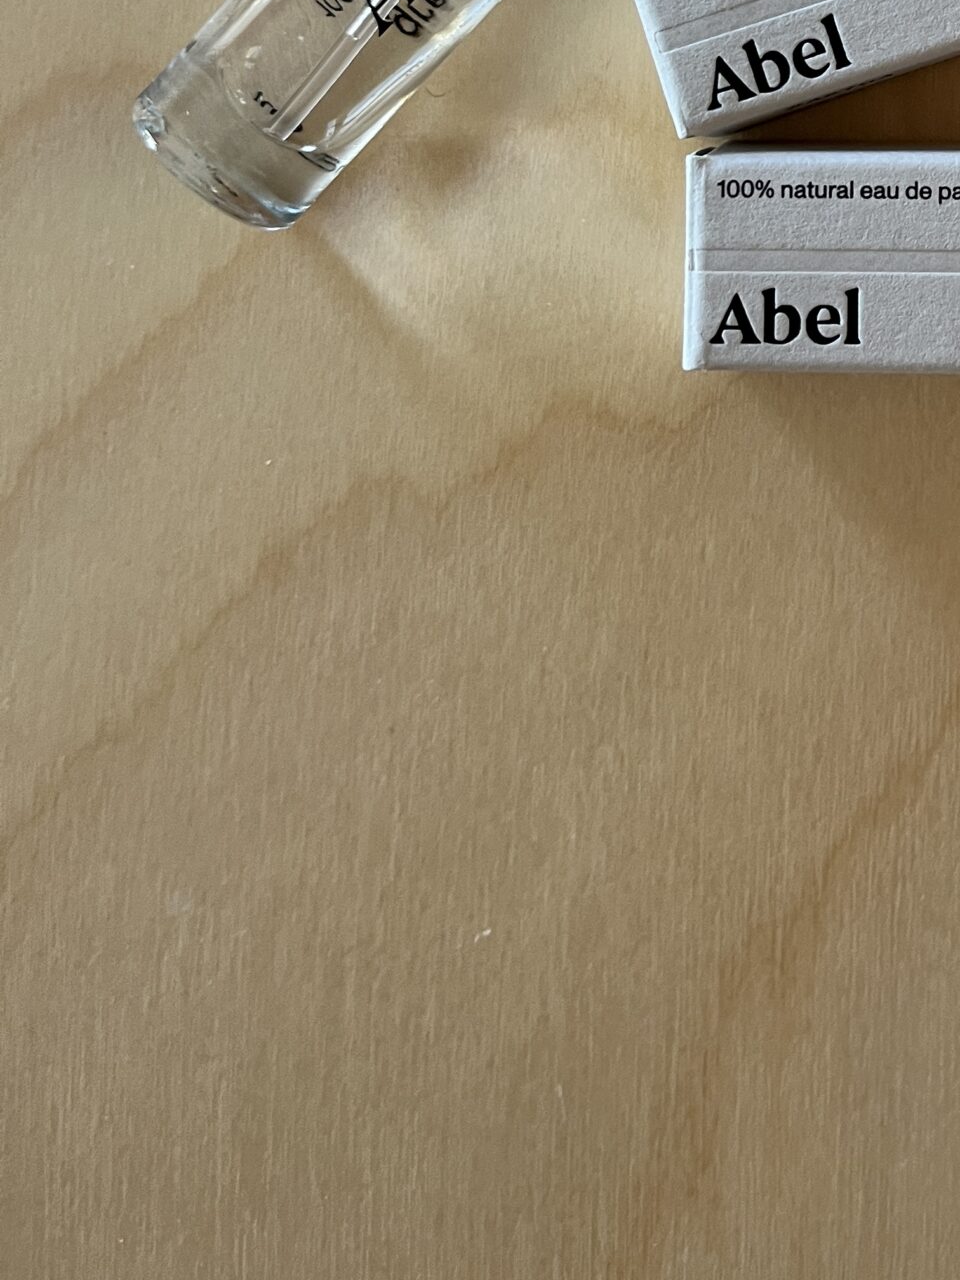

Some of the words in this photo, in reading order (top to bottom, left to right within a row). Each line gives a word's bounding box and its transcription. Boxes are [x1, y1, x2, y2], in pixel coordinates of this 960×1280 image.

[707, 13, 852, 112] Abel
[716, 179, 775, 199] 100%
[780, 180, 854, 200] natural
[859, 184, 900, 200] eau
[905, 181, 932, 200] de
[709, 287, 862, 346] Abel
